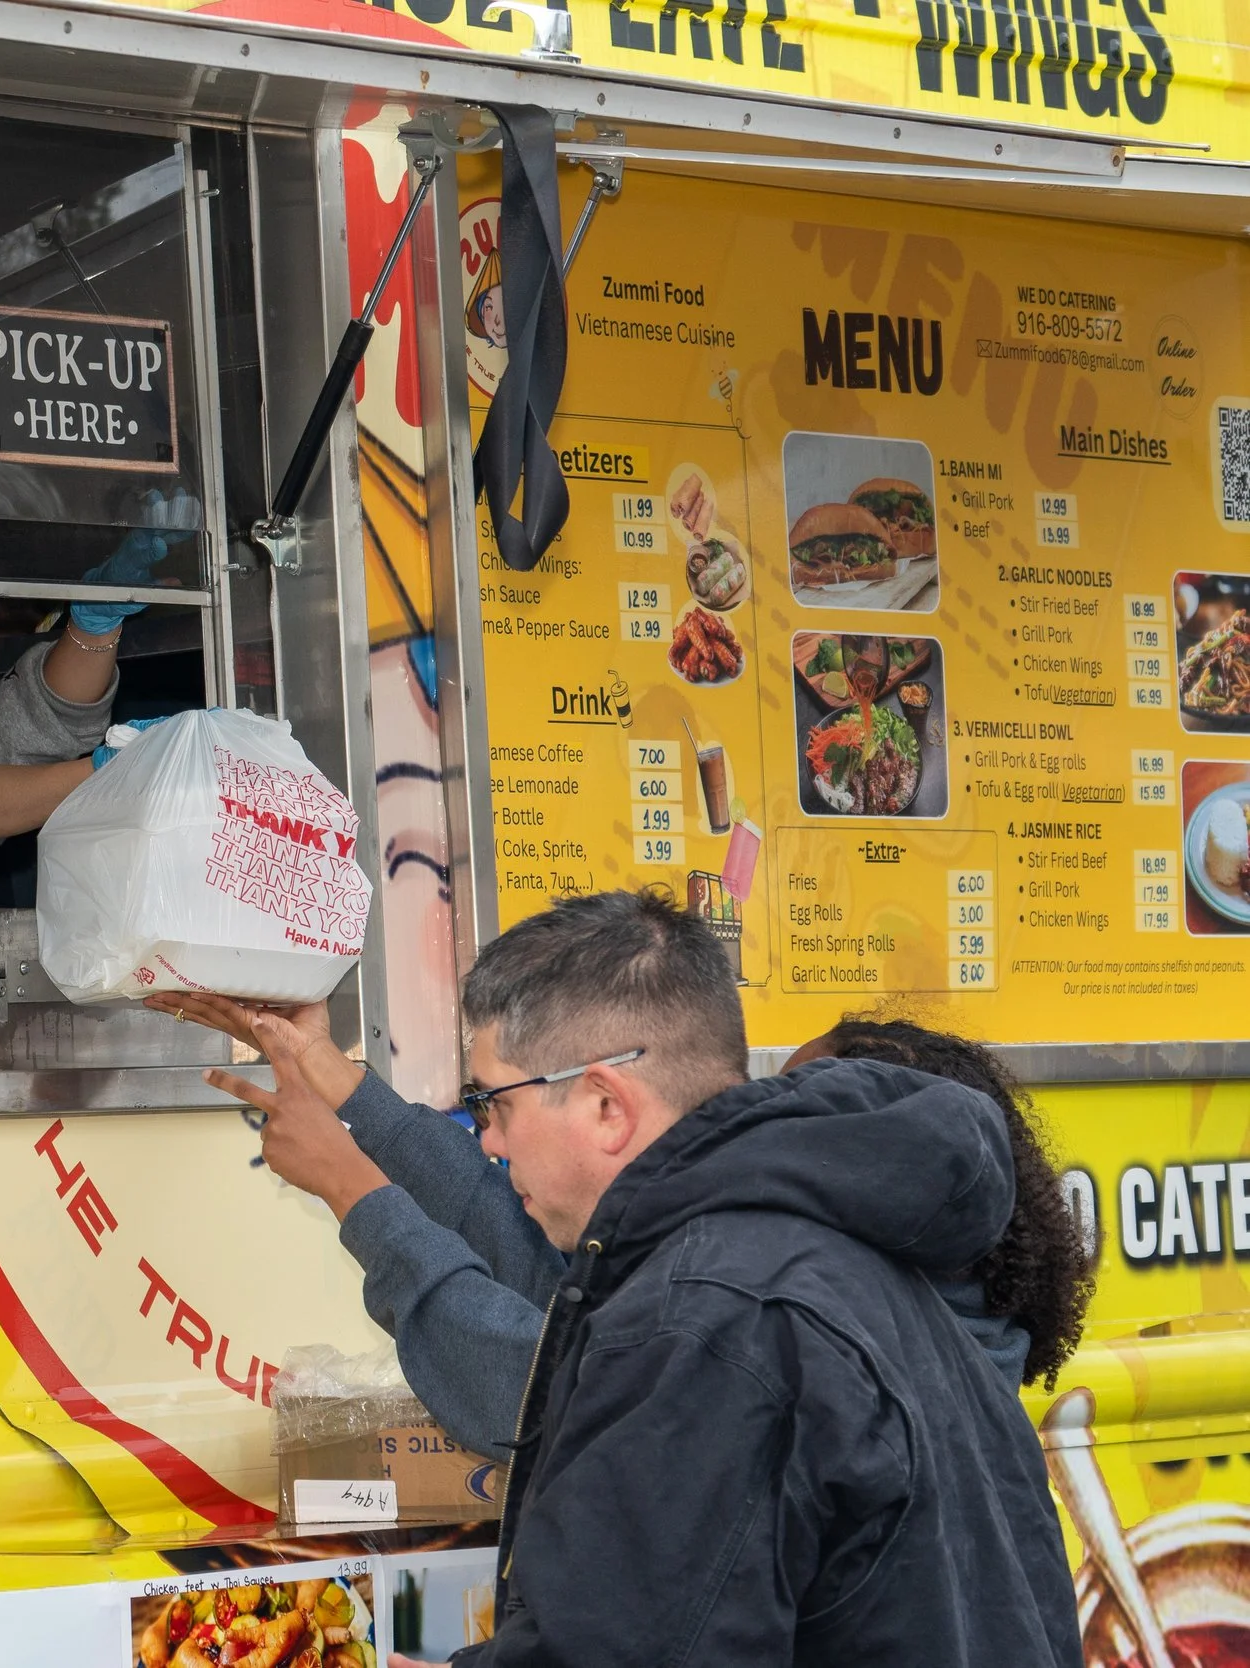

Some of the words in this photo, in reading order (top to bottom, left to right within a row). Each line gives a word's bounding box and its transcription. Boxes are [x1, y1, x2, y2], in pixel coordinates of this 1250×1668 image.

[603, 276, 659, 303] Zummi
[664, 282, 705, 306] Food
[1018, 286, 1035, 304] WE
[1038, 289, 1055, 306] DO
[1059, 291, 1116, 313] CATERING
[576, 313, 673, 342] Vietnamese
[677, 322, 736, 349] Cuisine
[1017, 311, 1123, 342] 916-809-5572
[803, 307, 943, 396] MENU
[995, 342, 1145, 373] Zummifood678@gmail.com
[1157, 336, 1198, 359] Online
[1161, 375, 1197, 398] Order
[1061, 425, 1104, 454] Main
[1110, 429, 1168, 459] Dishes
[940, 459, 985, 479] 1.BANH
[988, 463, 1003, 481] MI
[622, 498, 654, 519] 11.99
[962, 491, 986, 510] Grill
[989, 492, 1014, 511] Pork
[1042, 498, 1067, 516] 12.99
[623, 530, 653, 549] 10.99
[964, 520, 990, 539] Beef
[999, 565, 1009, 583] 2.
[1012, 566, 1054, 585] GARLIC
[1057, 568, 1113, 588] NOODLES
[500, 585, 541, 605] Sauce
[628, 590, 658, 609] 12.99
[1020, 596, 1040, 613] Stir
[1043, 597, 1071, 615] Fried
[1074, 598, 1099, 617] Beef
[1131, 602, 1155, 618] 18.99
[517, 617, 565, 641] Pepper
[569, 620, 610, 640] Sauce
[630, 620, 661, 640] 12.99
[1022, 626, 1046, 643] Grill
[1048, 627, 1073, 644] Pork
[1133, 631, 1158, 647] 17.99
[1023, 654, 1067, 673] Chicken
[1070, 656, 1103, 679] Wings
[1134, 659, 1160, 677] 17.99
[551, 686, 613, 716] Drink
[1136, 688, 1162, 706] 16.99
[953, 720, 964, 737] 3.
[966, 721, 1037, 740] VERMICELLI
[1040, 723, 1074, 741] BOWL
[490, 746, 534, 762] amese
[538, 743, 584, 763] Coffee
[638, 748, 666, 766] 7.00
[975, 750, 999, 768] Grill
[1002, 752, 1027, 769] Pork
[1029, 753, 1038, 769] &
[1040, 753, 1060, 774] Egg
[1062, 753, 1087, 771] rolls
[1139, 756, 1164, 773] 16.99
[508, 775, 579, 795] Lemonade
[640, 780, 667, 797] 6.00
[976, 780, 1000, 798] Tofu
[1004, 782, 1012, 798] &
[1014, 781, 1035, 803] Egg
[1062, 784, 1126, 804] Vegetarian)
[1140, 784, 1166, 801] 15.99
[219, 795, 328, 853] THANK
[502, 807, 544, 826] Bottle
[643, 809, 671, 831] 1.99
[1007, 822, 1018, 838] 4.
[1020, 822, 1073, 840] JASMINE
[1076, 823, 1102, 840] RICE
[502, 840, 540, 861] Coke,
[543, 840, 588, 862] Sprite,
[644, 840, 672, 861] 3.99
[1028, 851, 1048, 869] Stir
[1051, 852, 1079, 869] Fried
[1082, 852, 1108, 869] Beef
[211, 833, 319, 903] THANK
[1142, 858, 1167, 874] 18.99
[506, 872, 548, 892] Fanta,
[789, 873, 818, 891] Fries
[958, 875, 985, 893] 6.00
[1029, 881, 1053, 899] Grill
[1055, 882, 1080, 899] Pork
[205, 858, 314, 928] THANK
[1143, 885, 1169, 903] 17.99
[790, 904, 812, 926] Egg
[814, 904, 843, 922] Rolls
[958, 905, 984, 924] 3.00
[1029, 910, 1073, 928] Chicken
[1076, 911, 1109, 932] Wings
[1144, 912, 1169, 929] 17.99
[285, 927, 318, 948] Have
[319, 938, 330, 952] A
[791, 934, 823, 952] Fresh
[826, 934, 864, 956] Spring
[867, 934, 896, 952] Rolls
[959, 935, 985, 955] 5.99
[155, 954, 177, 975] Please
[176, 973, 198, 989] return
[792, 965, 827, 983] Garlic
[830, 965, 878, 983] Noodles
[960, 963, 985, 984] 8.00
[1011, 960, 1065, 975] (ATTENTION:
[1067, 960, 1084, 973] Our
[1084, 960, 1104, 973] food
[1105, 962, 1123, 976] may
[1125, 960, 1160, 973] contains
[1194, 960, 1210, 973] and
[1211, 960, 1246, 975] peanuts.
[1064, 982, 1080, 995] Our
[1081, 981, 1102, 996] price
[1103, 982, 1110, 994] is
[1112, 982, 1126, 994] not
[1128, 981, 1163, 994] included
[1165, 982, 1173, 994] in
[1174, 981, 1199, 995] taxes)
[337, 1561, 369, 1578] 13.99
[143, 1582, 180, 1598] Chicken
[184, 1578, 204, 1593] feet
[210, 1582, 221, 1590] w
[224, 1576, 241, 1590] Thai
